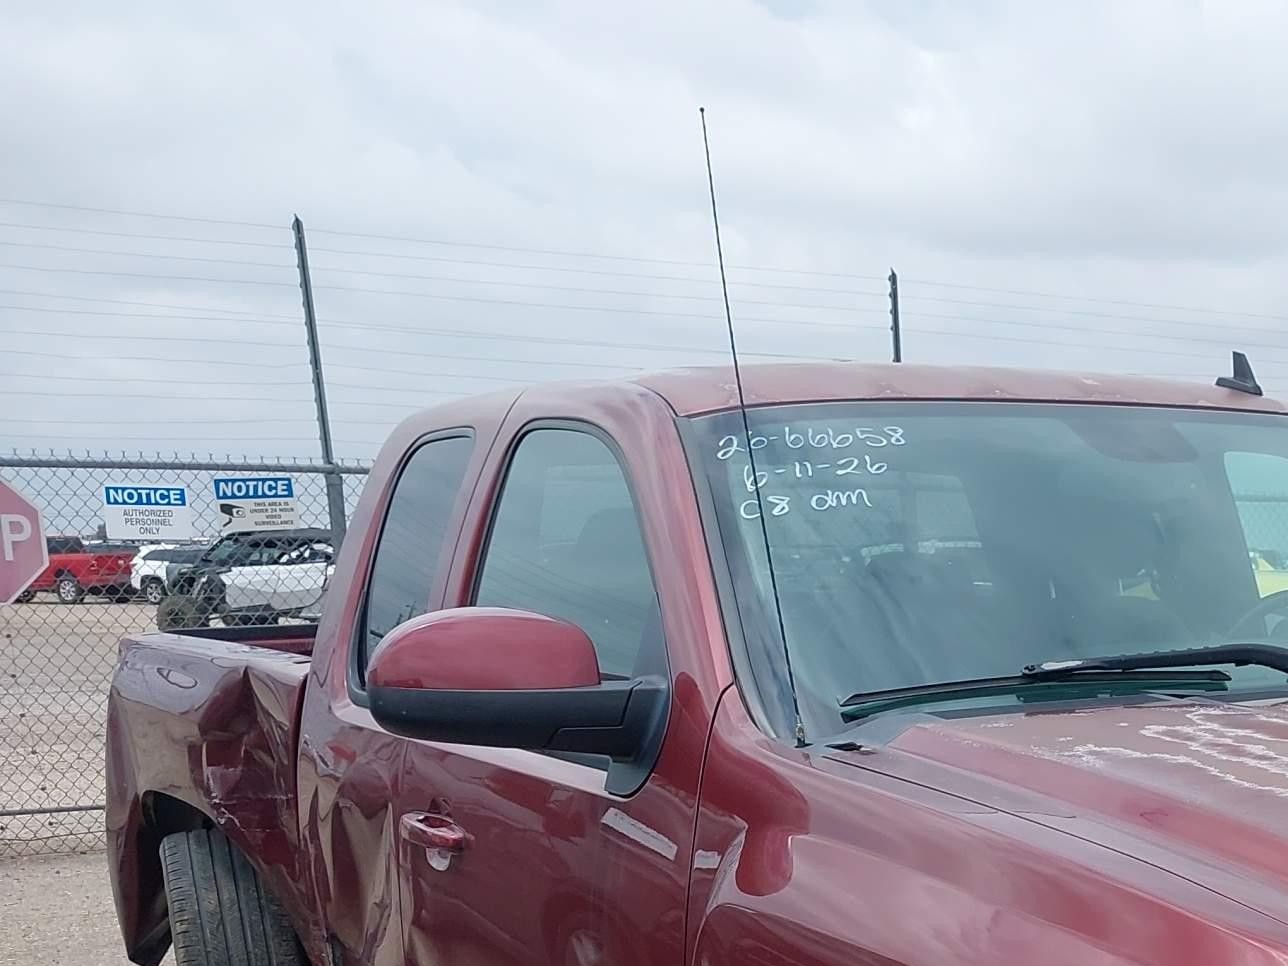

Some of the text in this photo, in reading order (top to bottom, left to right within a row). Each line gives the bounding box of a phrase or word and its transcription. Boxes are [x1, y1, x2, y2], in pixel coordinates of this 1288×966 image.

[219, 480, 289, 496] NOTICE
[109, 489, 182, 504] NOTICE
[122, 509, 173, 517] AUTHORIZED
[124, 518, 173, 526] PERSONNEL
[139, 526, 161, 535] ONLY
